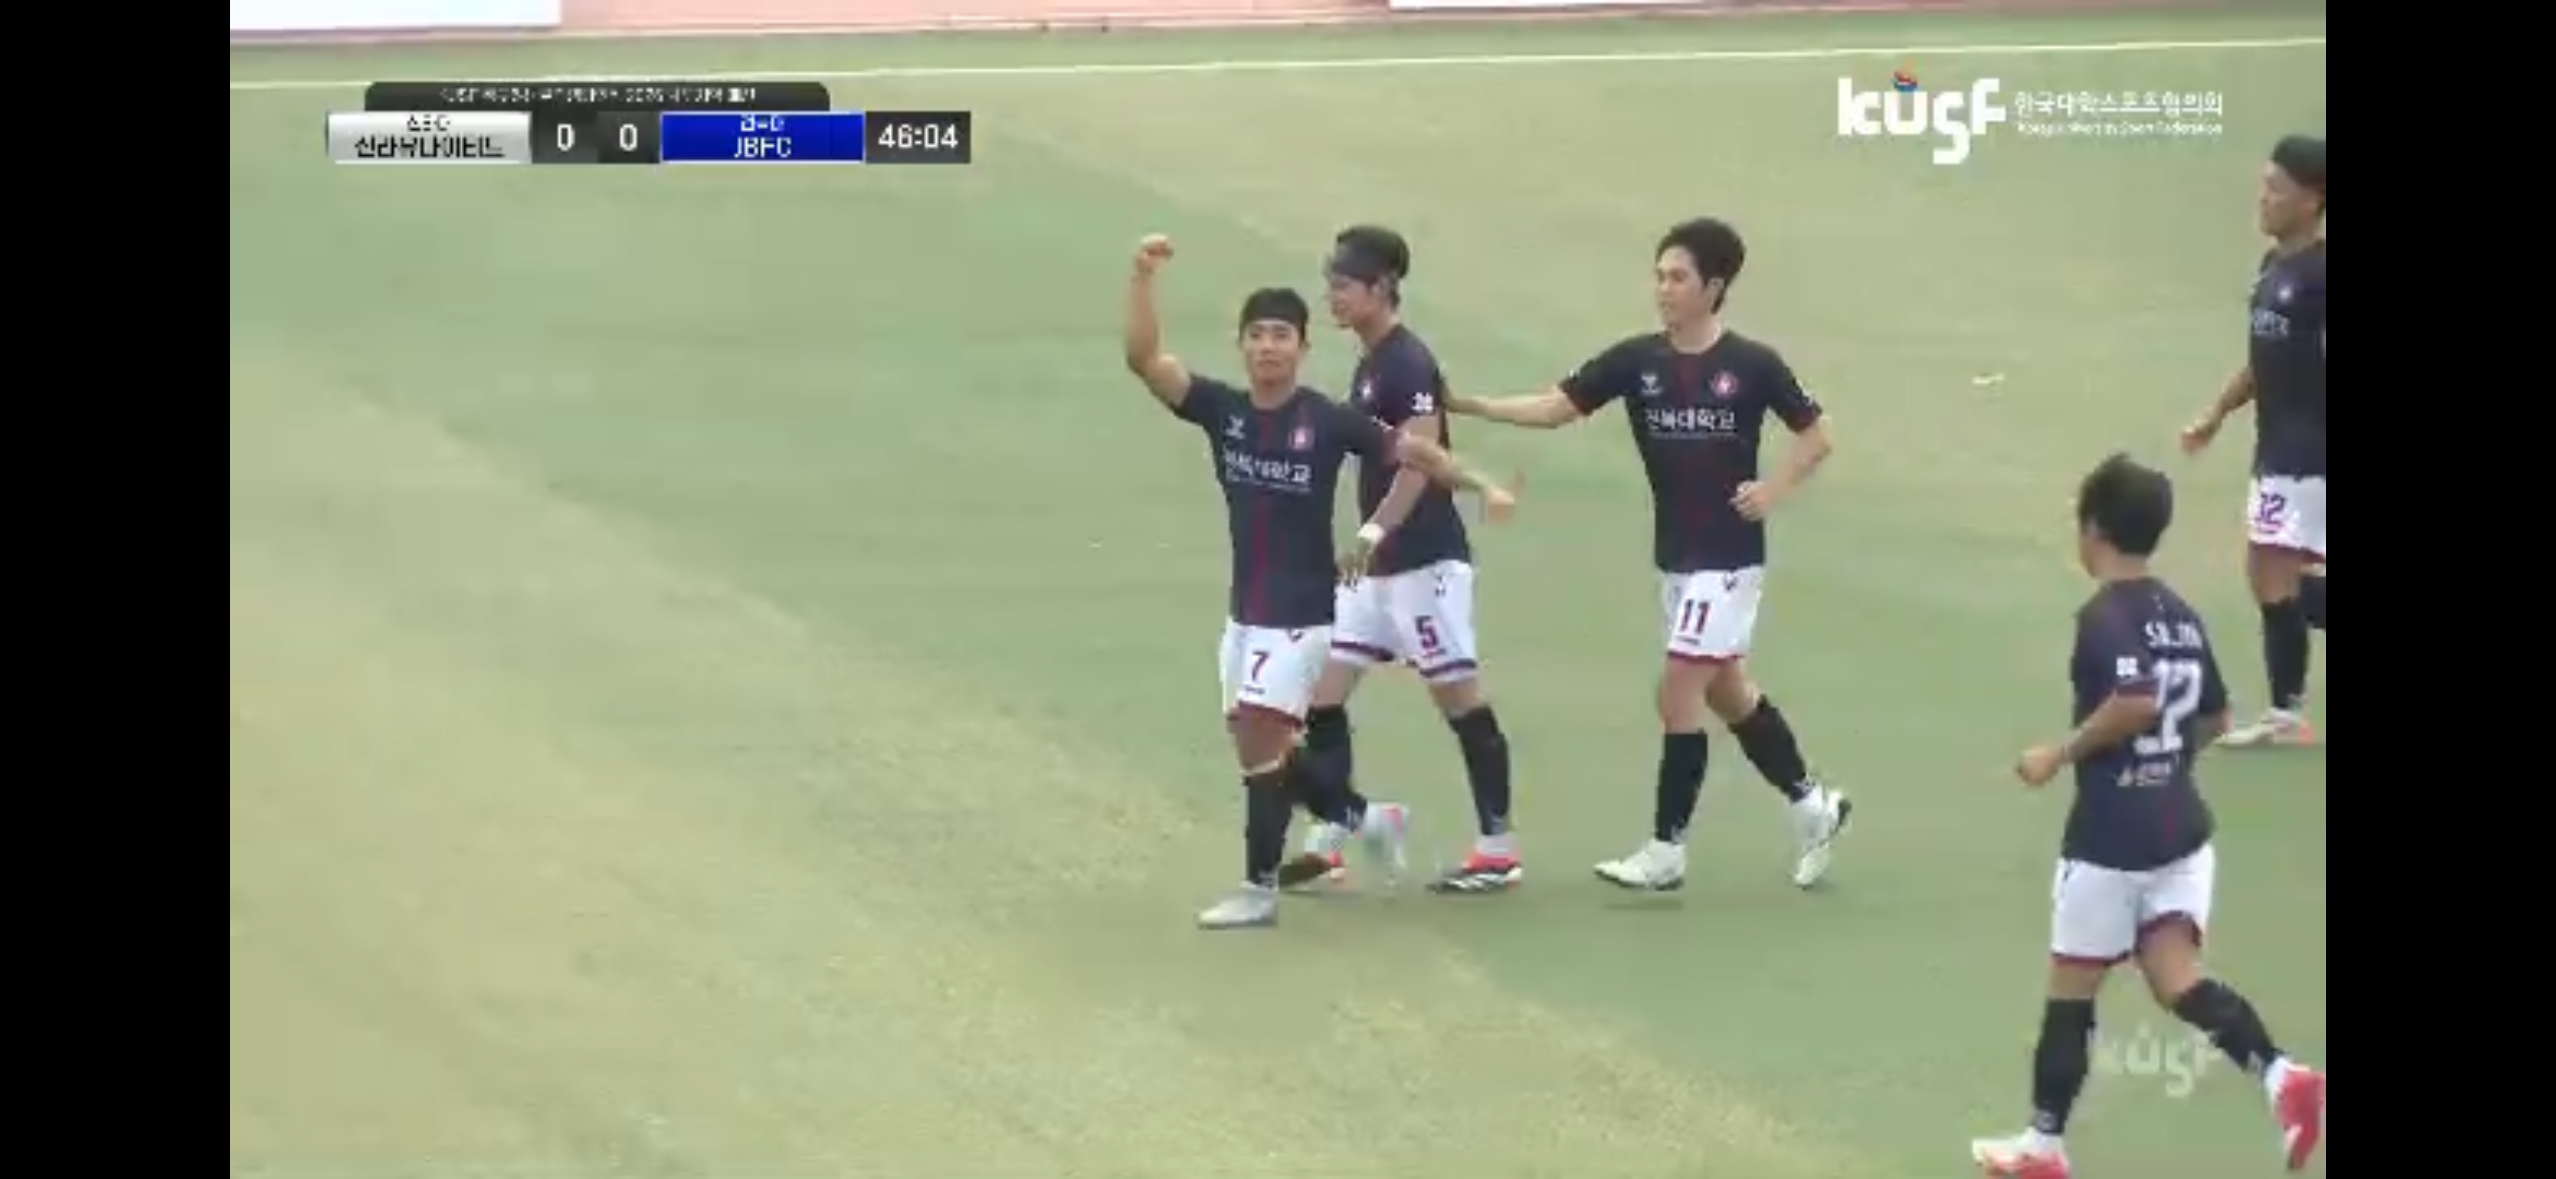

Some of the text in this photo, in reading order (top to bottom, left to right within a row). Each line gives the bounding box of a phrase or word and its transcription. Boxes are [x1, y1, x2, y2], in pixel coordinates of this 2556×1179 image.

[1415, 615, 1439, 649] 5
[1680, 598, 1710, 635] 11
[1251, 651, 1270, 682] 7
